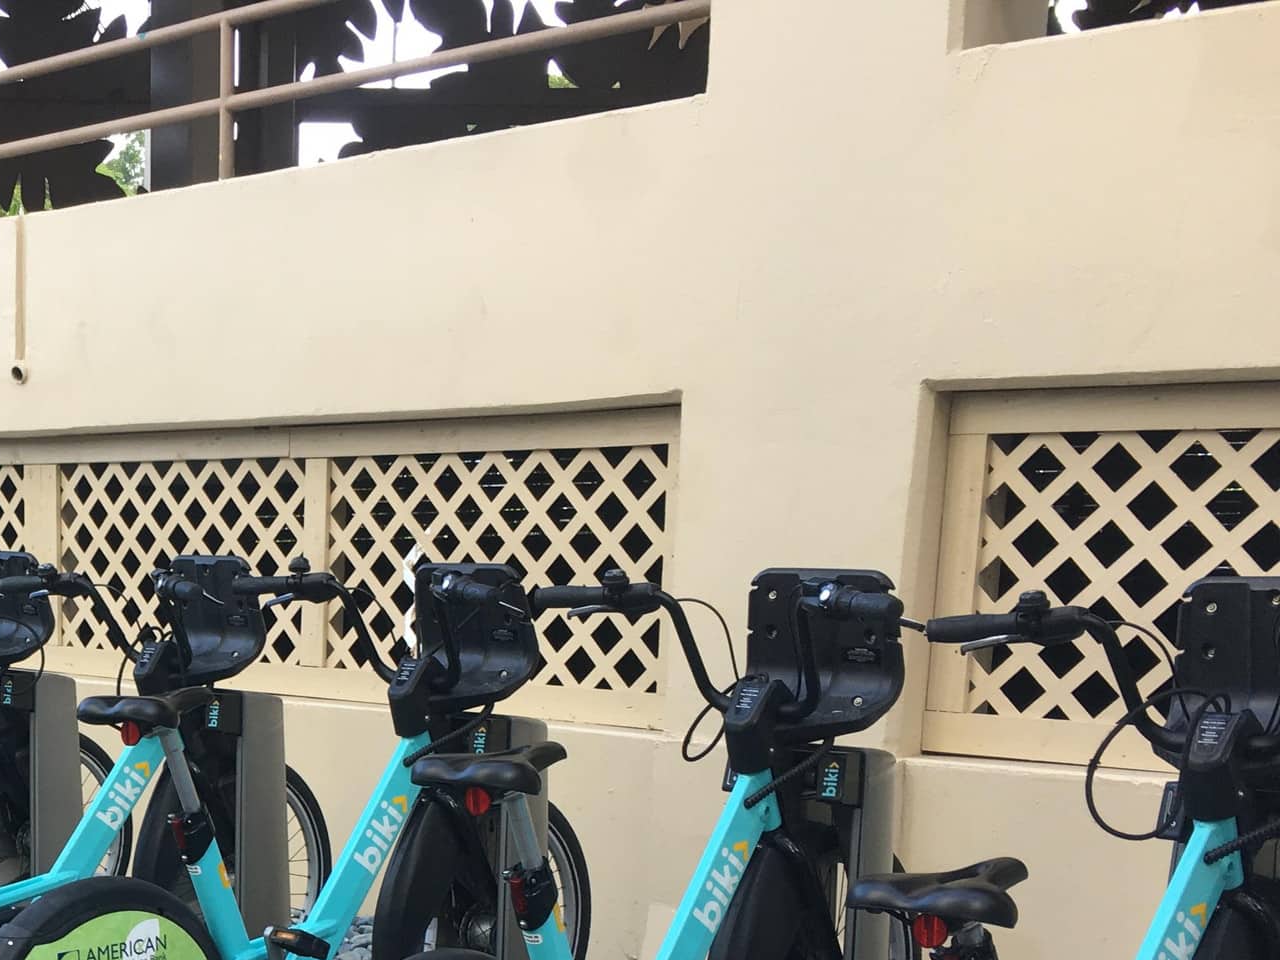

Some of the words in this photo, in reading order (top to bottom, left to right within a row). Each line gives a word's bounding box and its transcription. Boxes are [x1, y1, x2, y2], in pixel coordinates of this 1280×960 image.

[207, 705, 221, 729] biki
[95, 766, 148, 832] biki
[821, 768, 840, 798] biki
[352, 799, 404, 877] biki
[692, 846, 743, 935] biki
